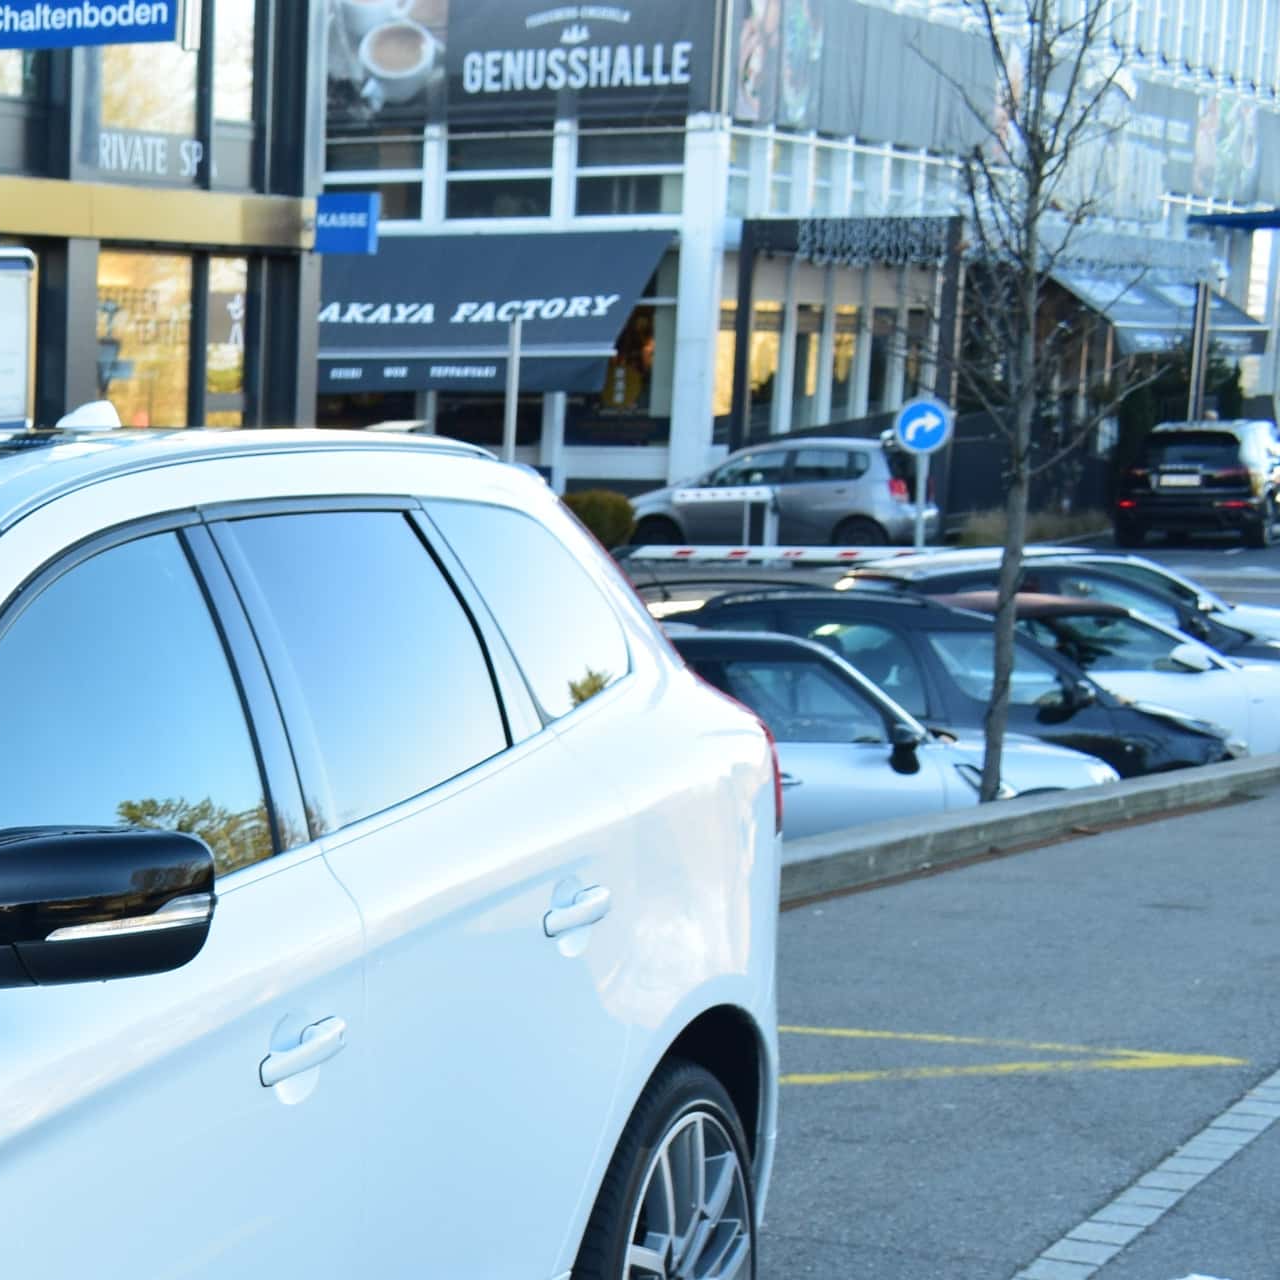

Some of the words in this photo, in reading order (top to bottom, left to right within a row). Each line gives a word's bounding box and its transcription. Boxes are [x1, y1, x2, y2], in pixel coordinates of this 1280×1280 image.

[463, 41, 693, 93] GENUSSHALLE
[180, 140, 218, 177] SP
[318, 211, 369, 229] KASSE
[450, 294, 621, 324] FACTORY
